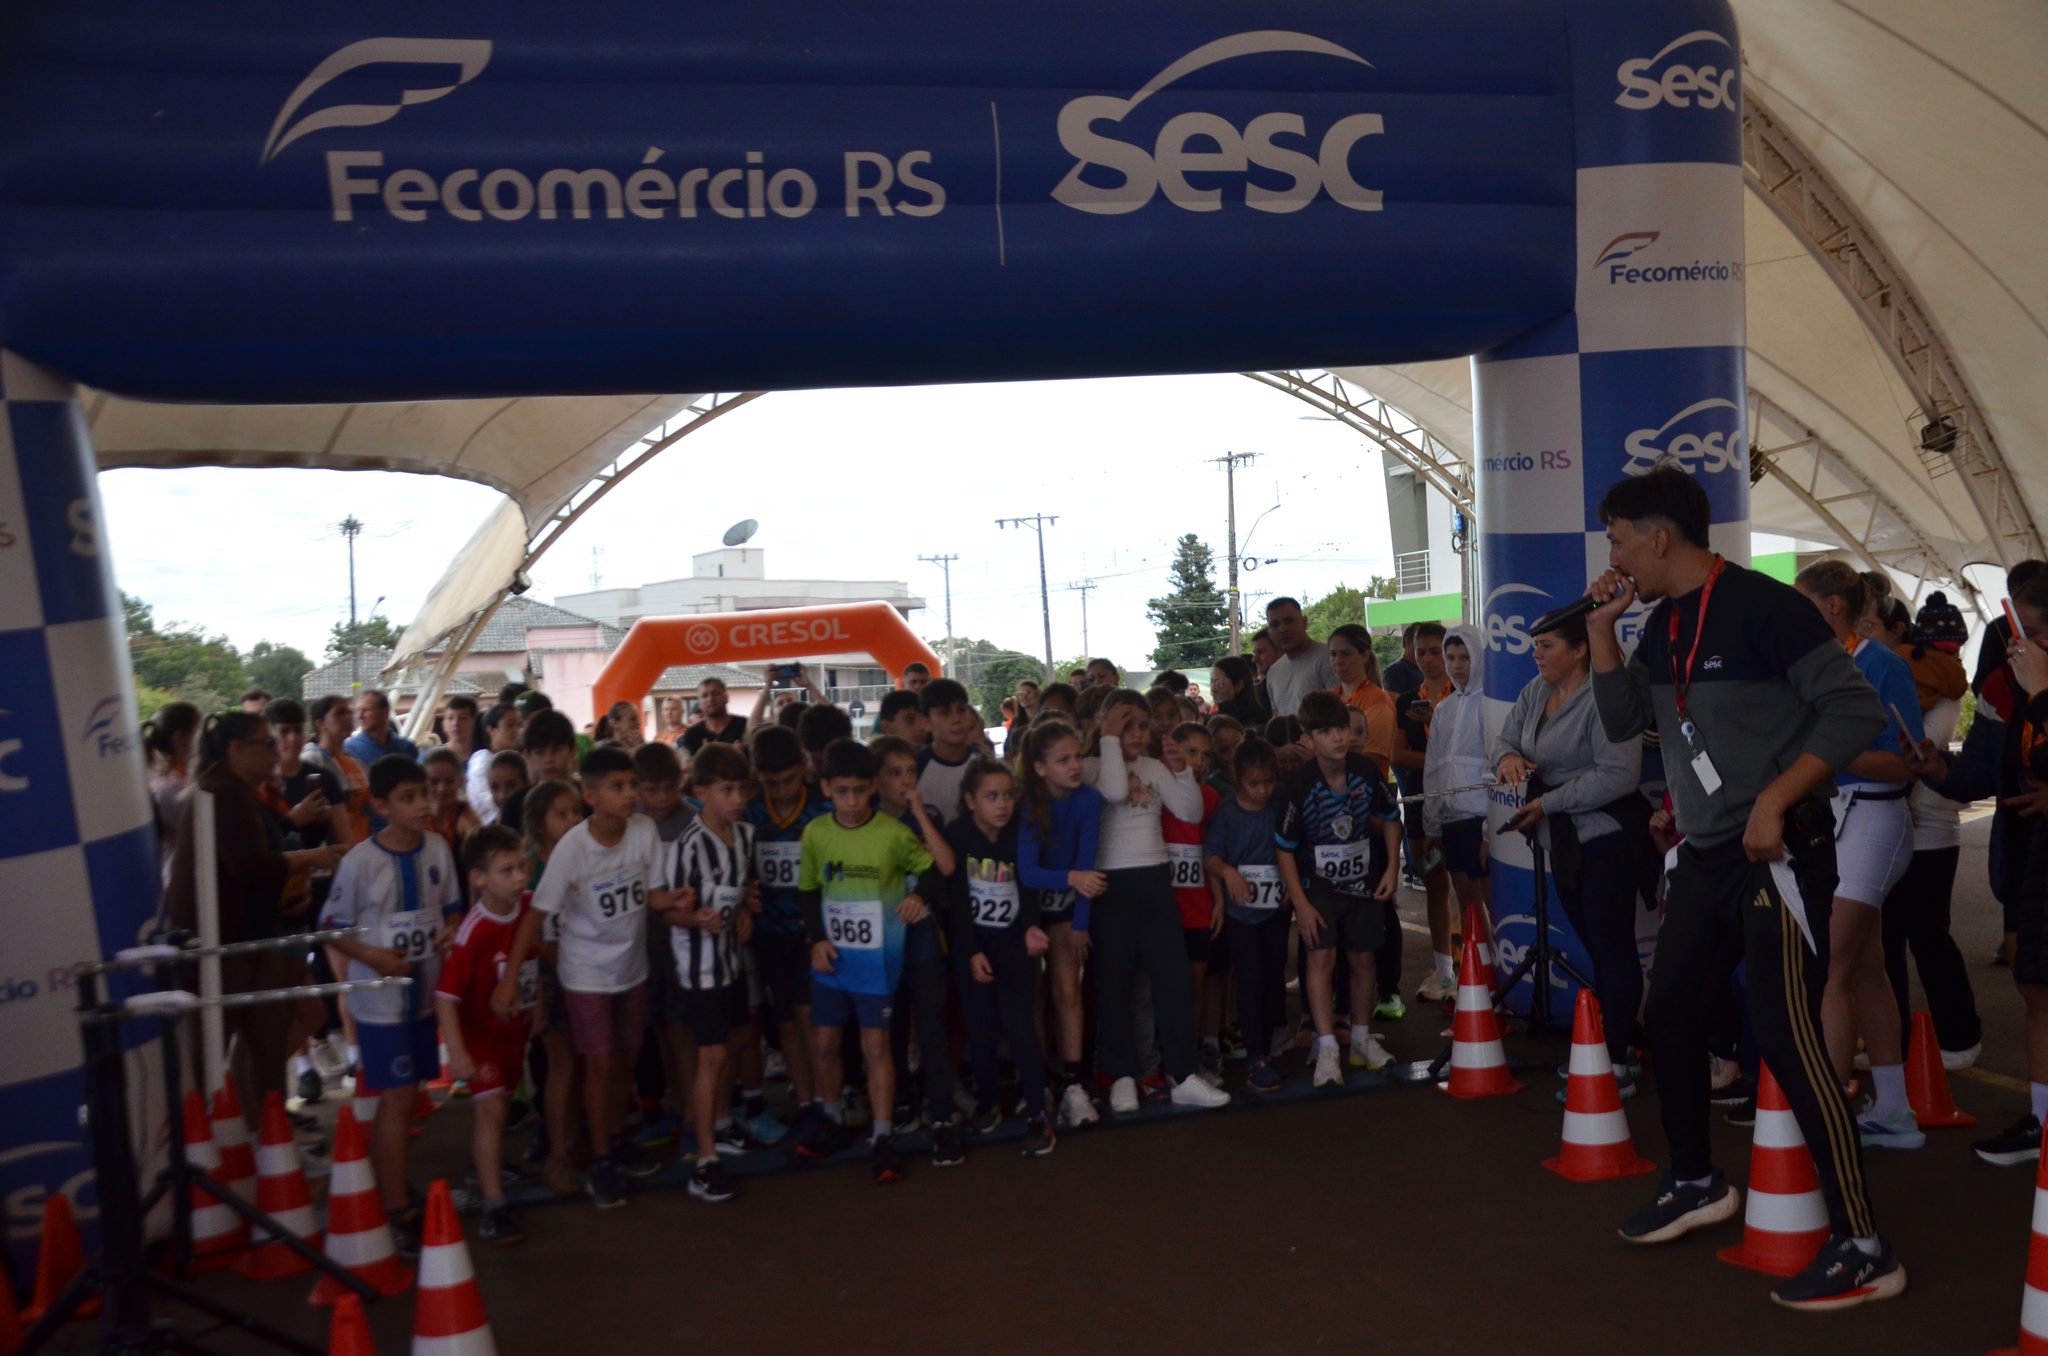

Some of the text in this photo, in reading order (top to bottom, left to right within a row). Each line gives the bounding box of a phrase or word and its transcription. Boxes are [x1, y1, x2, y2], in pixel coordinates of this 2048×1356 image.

[326, 146, 946, 222] Fecomércio RS
[1610, 259, 1729, 284] Fecomércio
[1541, 449, 1572, 470] RS
[729, 617, 850, 648] CRESOL
[764, 859, 800, 883] 98
[1324, 856, 1364, 878] 985
[600, 880, 646, 917] 976
[969, 896, 1012, 922] 922
[831, 917, 872, 944] 968
